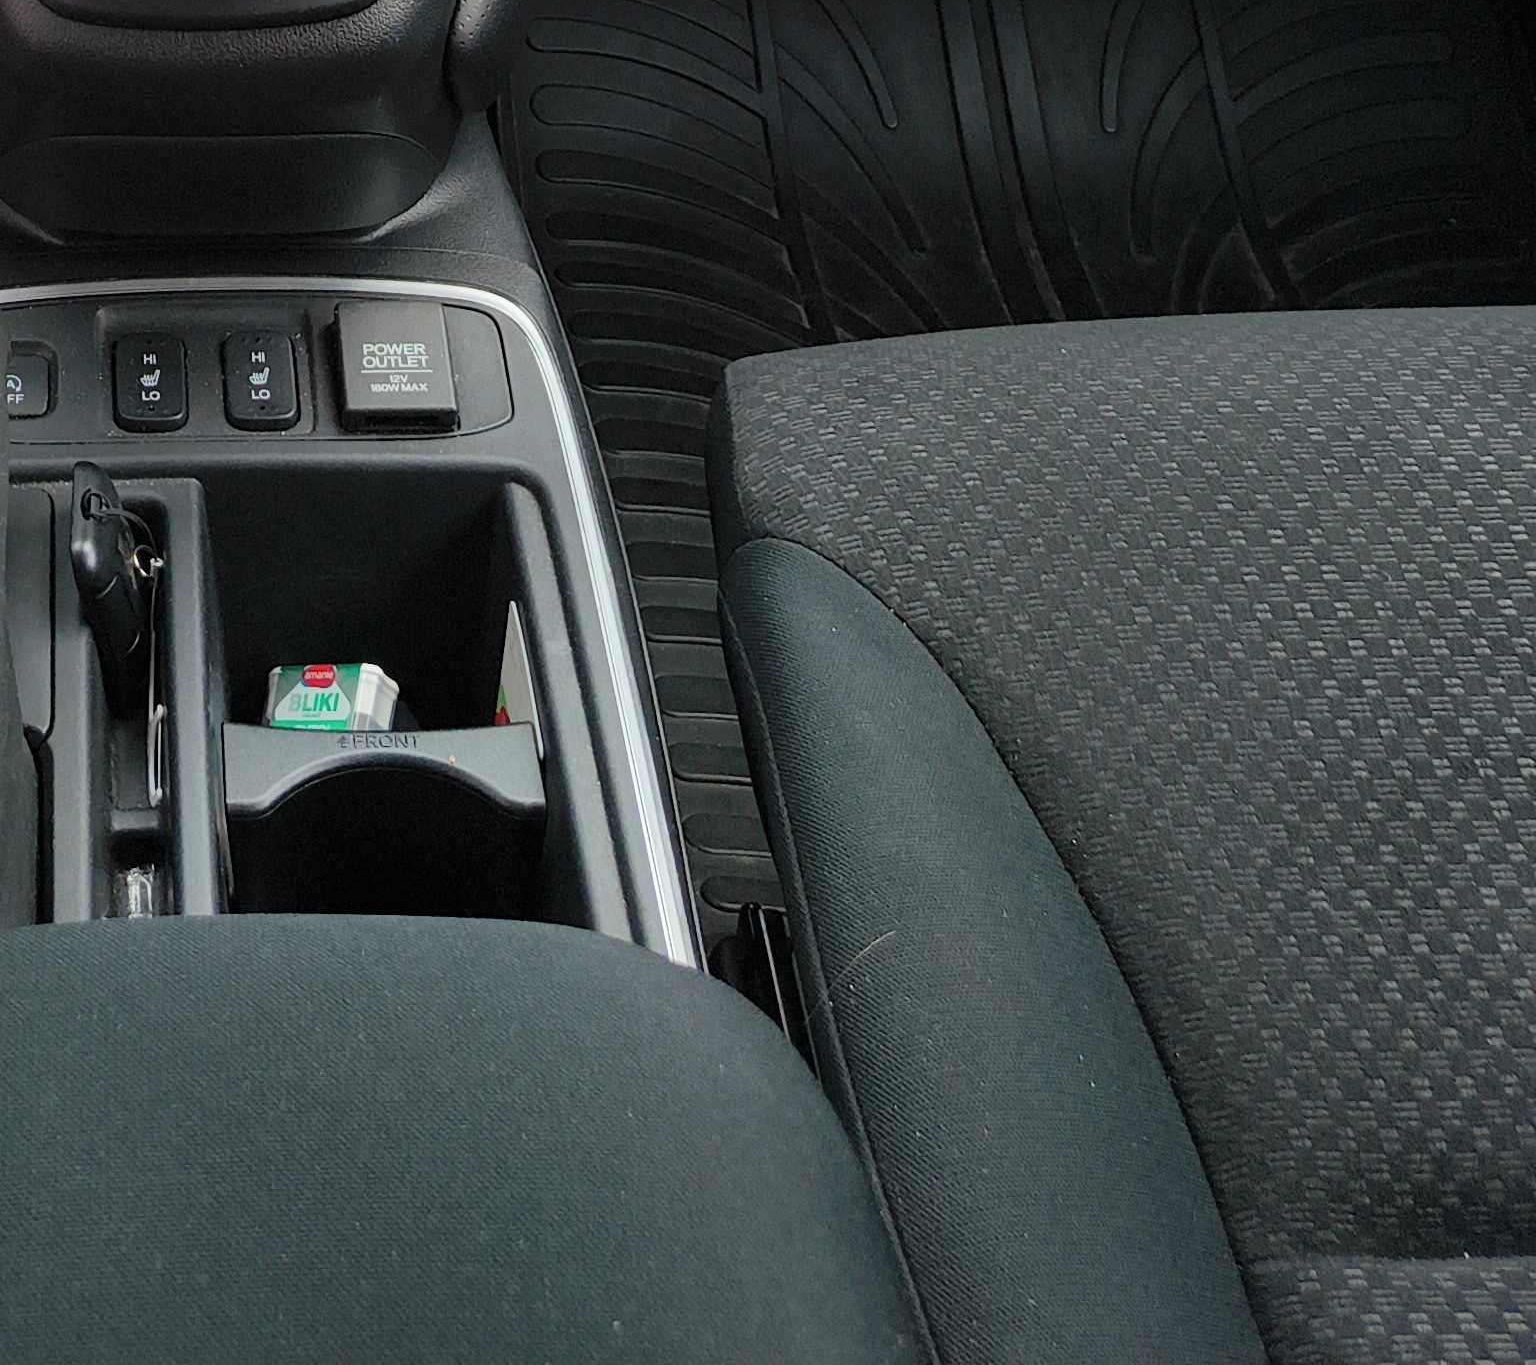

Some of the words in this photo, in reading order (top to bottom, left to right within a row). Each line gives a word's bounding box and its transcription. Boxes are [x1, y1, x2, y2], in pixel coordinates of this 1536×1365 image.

[362, 343, 426, 355] POWER
[143, 354, 157, 365] HI
[251, 352, 266, 363] HI
[362, 355, 429, 368] OUTLET
[389, 374, 408, 383] 12V
[401, 383, 428, 392] MAX
[141, 390, 161, 401] LO
[251, 389, 271, 400] LO
[288, 692, 340, 712] BLIKI
[353, 734, 420, 749] FRONT
